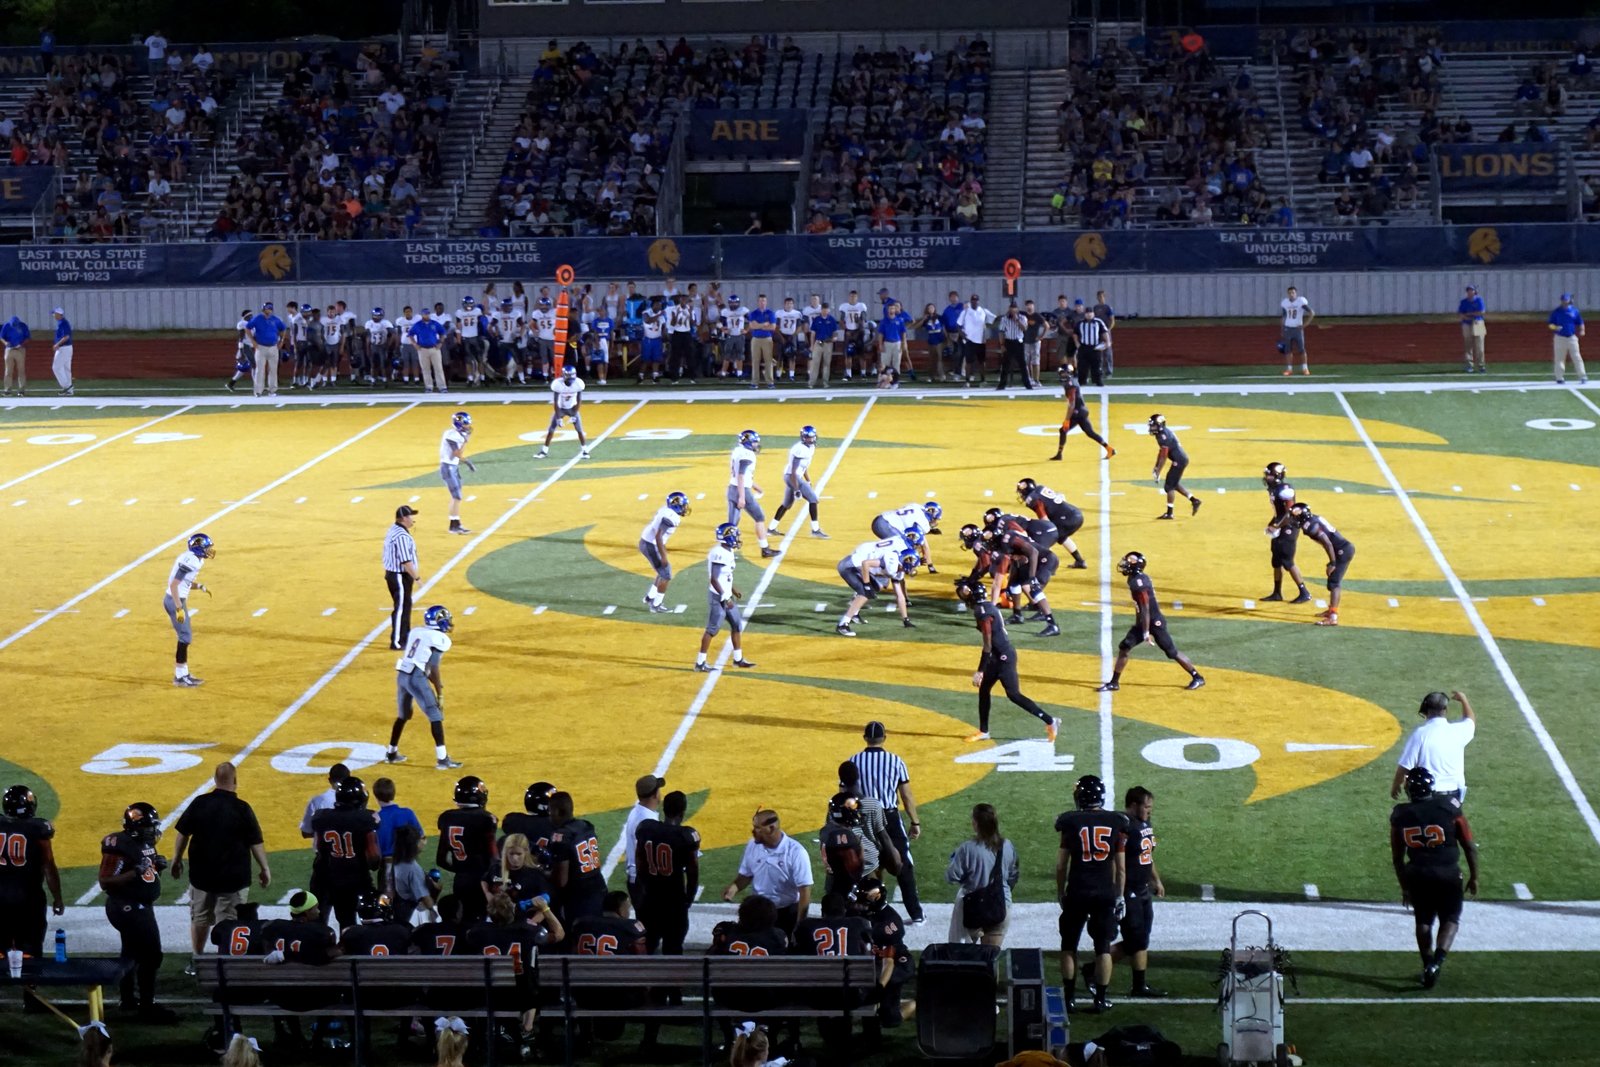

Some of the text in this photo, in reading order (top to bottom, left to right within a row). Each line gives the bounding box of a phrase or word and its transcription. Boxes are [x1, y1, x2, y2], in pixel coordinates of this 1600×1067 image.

[711, 119, 780, 141] ARE
[1440, 152, 1555, 179] LIONS
[1, 178, 24, 200] E
[828, 236, 961, 248] EAST TEXAS STATE
[1220, 231, 1354, 243] EAST TEXAS STATE
[406, 242, 537, 253] EAST TEXAS STATE
[866, 248, 928, 258] COLLEGE
[1244, 243, 1329, 254] UNIVERSITY
[17, 249, 147, 260] EAST TEXAS STATE
[403, 253, 541, 264] TEACHERS COLLEGE
[1256, 254, 1318, 265] 1962-1996
[21, 260, 145, 271] NORMAL COLLEGE
[443, 264, 502, 275] 1923-1957
[865, 259, 925, 269] 1957-1962
[56, 271, 111, 282] 1917-1923
[1403, 824, 1446, 849] 52
[323, 829, 356, 860] 31
[448, 825, 467, 862] 5
[1078, 825, 1113, 863] 15
[644, 839, 674, 877] 10
[230, 926, 252, 956] 6
[435, 935, 456, 956] 7
[814, 926, 849, 957] 21
